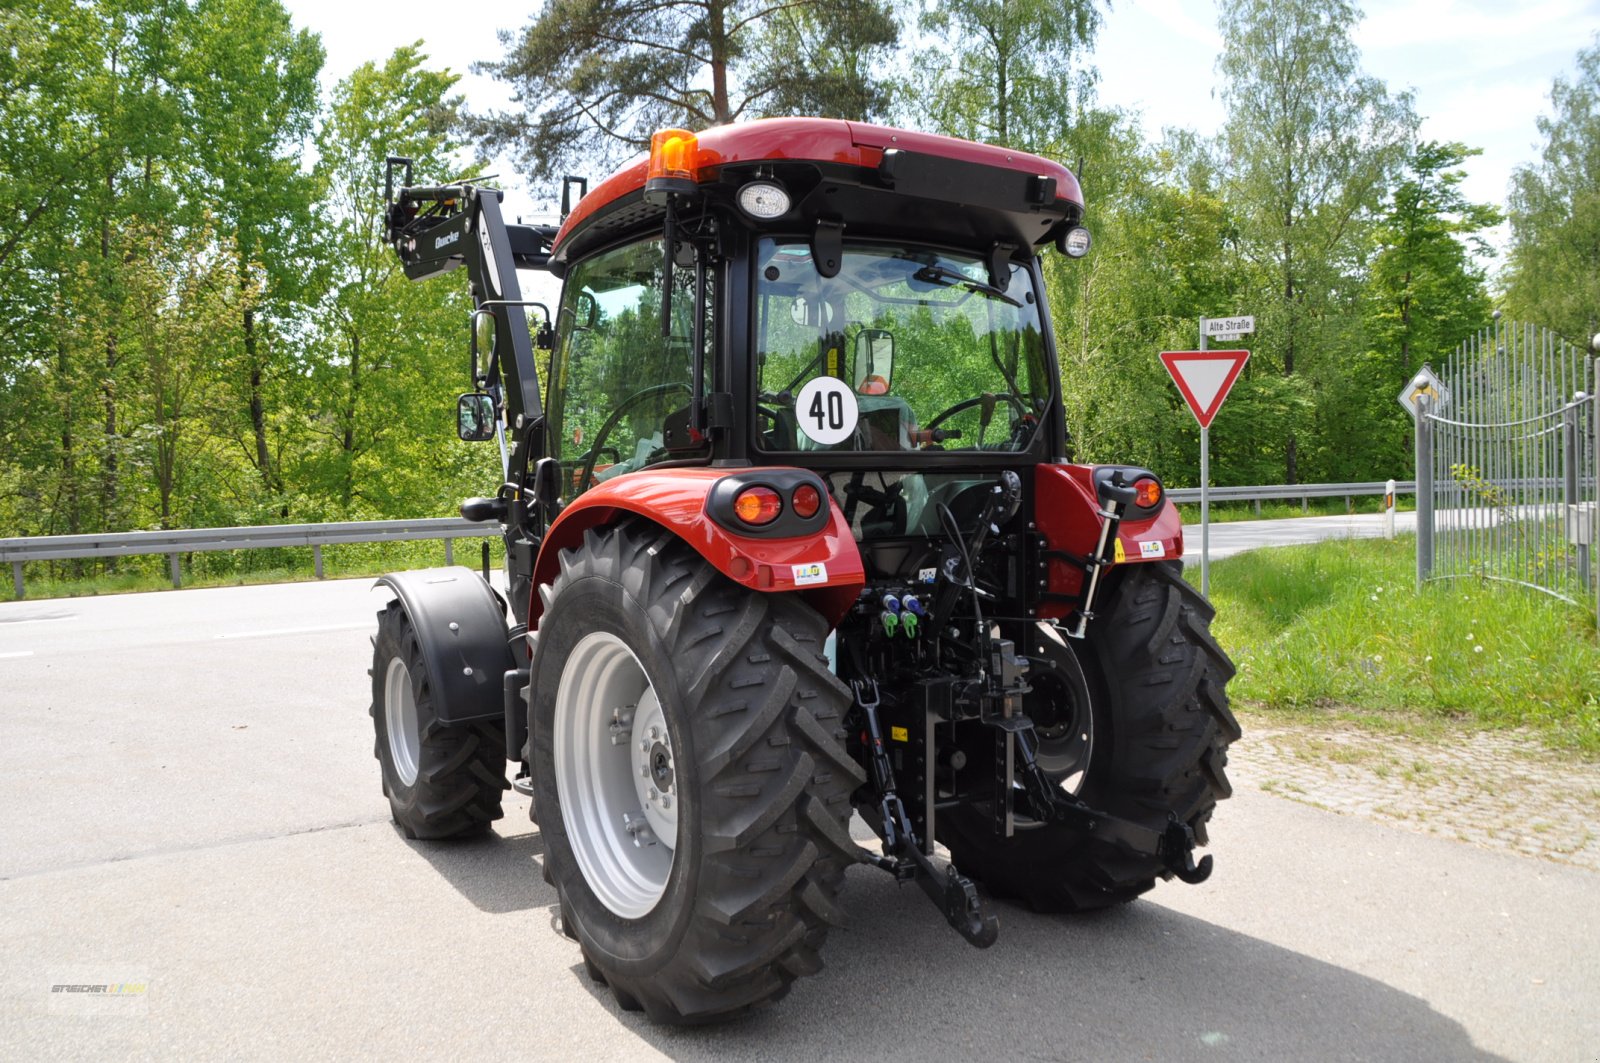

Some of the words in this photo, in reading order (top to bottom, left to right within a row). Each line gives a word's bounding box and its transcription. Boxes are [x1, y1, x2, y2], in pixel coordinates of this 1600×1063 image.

[1209, 321, 1224, 332] Alte
[1225, 319, 1250, 331] Straße
[809, 390, 844, 430] 40
